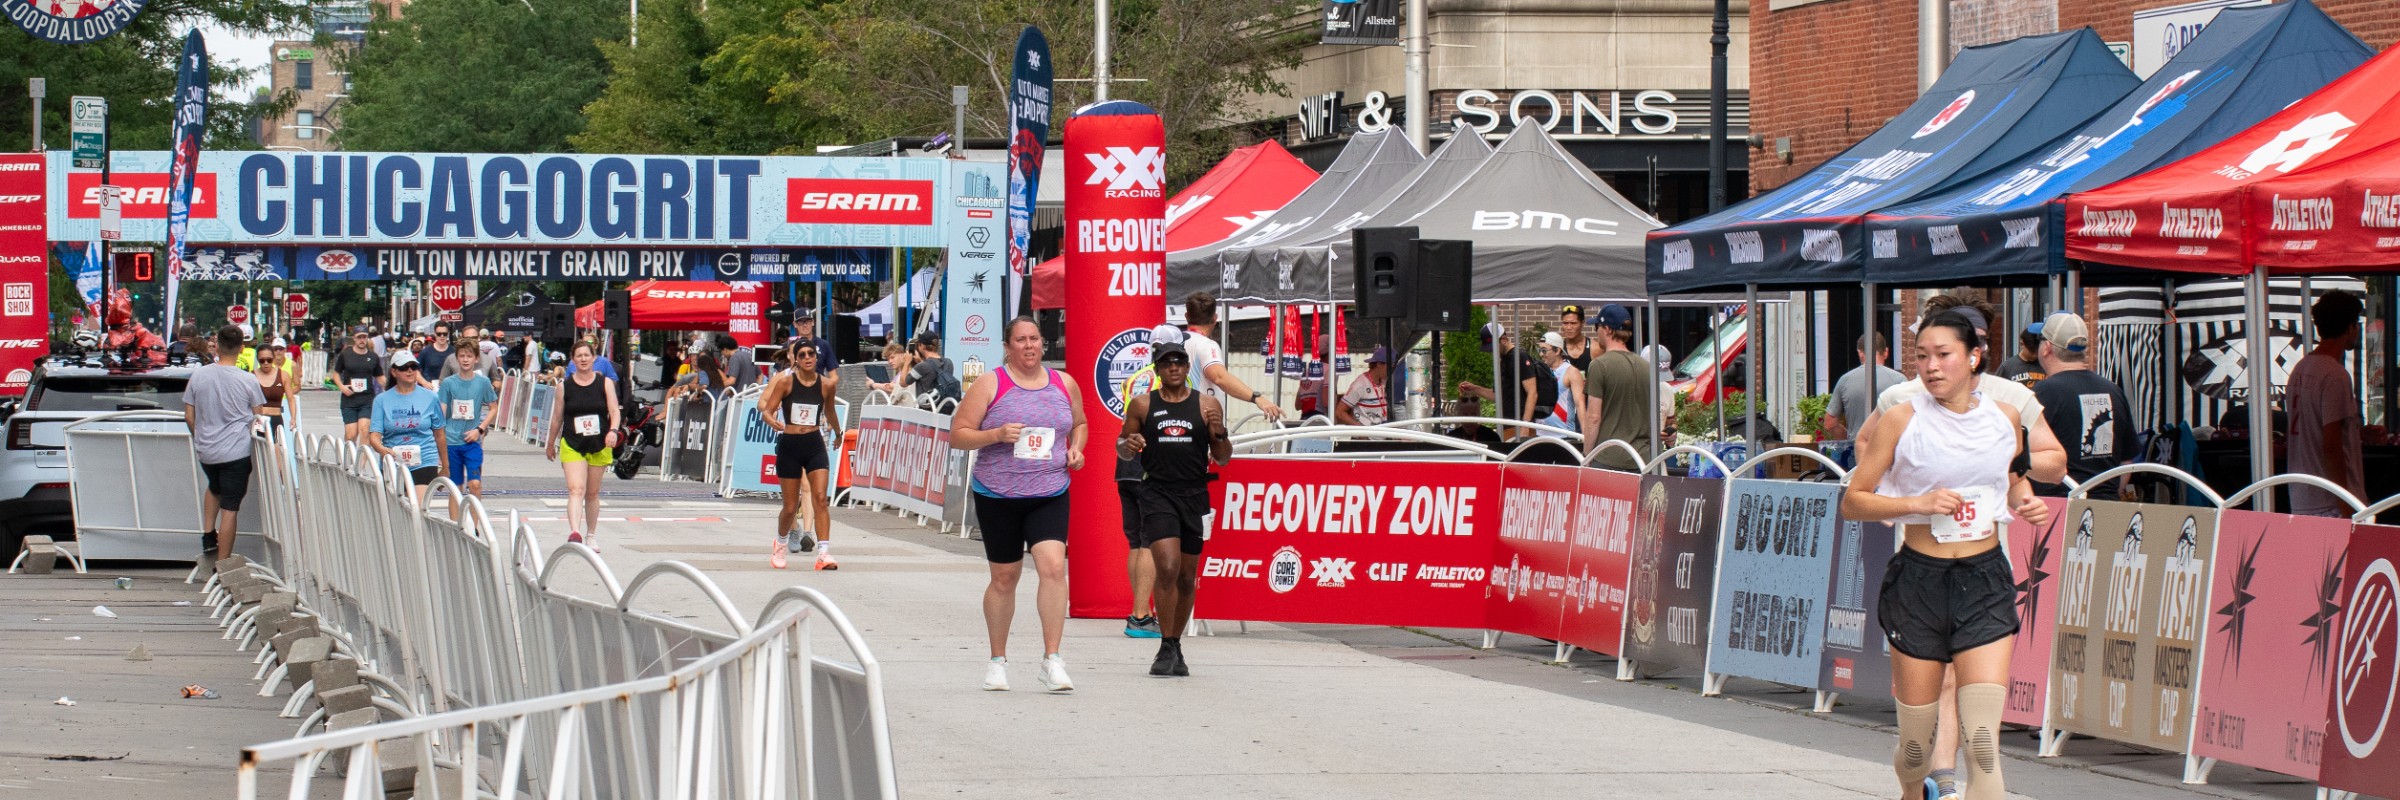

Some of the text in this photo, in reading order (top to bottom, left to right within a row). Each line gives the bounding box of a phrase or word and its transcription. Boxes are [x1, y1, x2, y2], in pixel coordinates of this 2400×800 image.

[1365, 15, 1396, 26] Allsteel
[1300, 89, 1678, 141] SWIFT & SONS
[239, 154, 763, 241] CHICAGOGRIT
[801, 192, 919, 212] SRAM
[956, 196, 1005, 208] CHICAGOGRIT
[1105, 190, 1160, 198] RACING
[1472, 209, 1619, 236] BMC
[2078, 205, 2137, 237] ATHLETICO
[2159, 202, 2223, 239] ATHLETICO
[2270, 193, 2334, 231] ATHLETICO
[2360, 188, 2400, 229] ATHLE
[1078, 218, 1166, 253] RECOVER
[135, 253, 151, 280] 0
[377, 249, 685, 277] FULTON MARKET GRAND PRIX
[750, 254, 790, 263] POWERED BY
[750, 264, 871, 275] HOWARD ORLOFF VOLVO CARS
[7, 286, 30, 299] ROCK
[1108, 263, 1162, 297] ZONE
[8, 301, 30, 313] SHOX
[647, 290, 730, 299] SRAM
[230, 310, 247, 319] STOP
[730, 302, 758, 316] RACER
[730, 319, 761, 333] CORRAL
[0, 339, 43, 348] TIME
[1103, 332, 1136, 361] FULTON
[964, 364, 983, 375] USA
[459, 405, 467, 413] 63
[799, 409, 809, 417] 73
[583, 420, 592, 429] 64
[1157, 419, 1193, 430] CHICAGO
[402, 451, 411, 460] 96
[876, 428, 899, 479] CLIF
[1028, 435, 1042, 448] 69
[1222, 482, 1477, 536] RECOVERY ZONE
[1500, 487, 1571, 542] RECOVERY ZONE
[1678, 494, 1706, 534] LET'S
[1575, 493, 1633, 554] RECOVERY ZONE
[1734, 493, 1828, 558] BIG GRIT
[1202, 556, 1263, 579] BMC
[1275, 575, 1295, 586] POWER
[1276, 561, 1296, 575] CORE
[1368, 562, 1408, 581] CLIF
[1415, 563, 1486, 581] ATHLETICO
[1675, 552, 1695, 589] GET
[2062, 561, 2092, 627] USA
[2108, 565, 2142, 634] USA
[2161, 570, 2197, 641] USA
[1667, 606, 1698, 646] GRITTY
[2056, 631, 2087, 674] MASTERS
[2102, 637, 2137, 681] MASTERS
[1835, 666, 1852, 680] SRAM
[2153, 644, 2192, 690] MASTERS
[2007, 676, 2036, 713] METEOR
[2062, 672, 2078, 720] CUP
[2109, 680, 2126, 728] CUP
[2159, 688, 2179, 737] CUP
[2202, 706, 2246, 751] THE METEOR
[2285, 721, 2324, 766] THE METE
